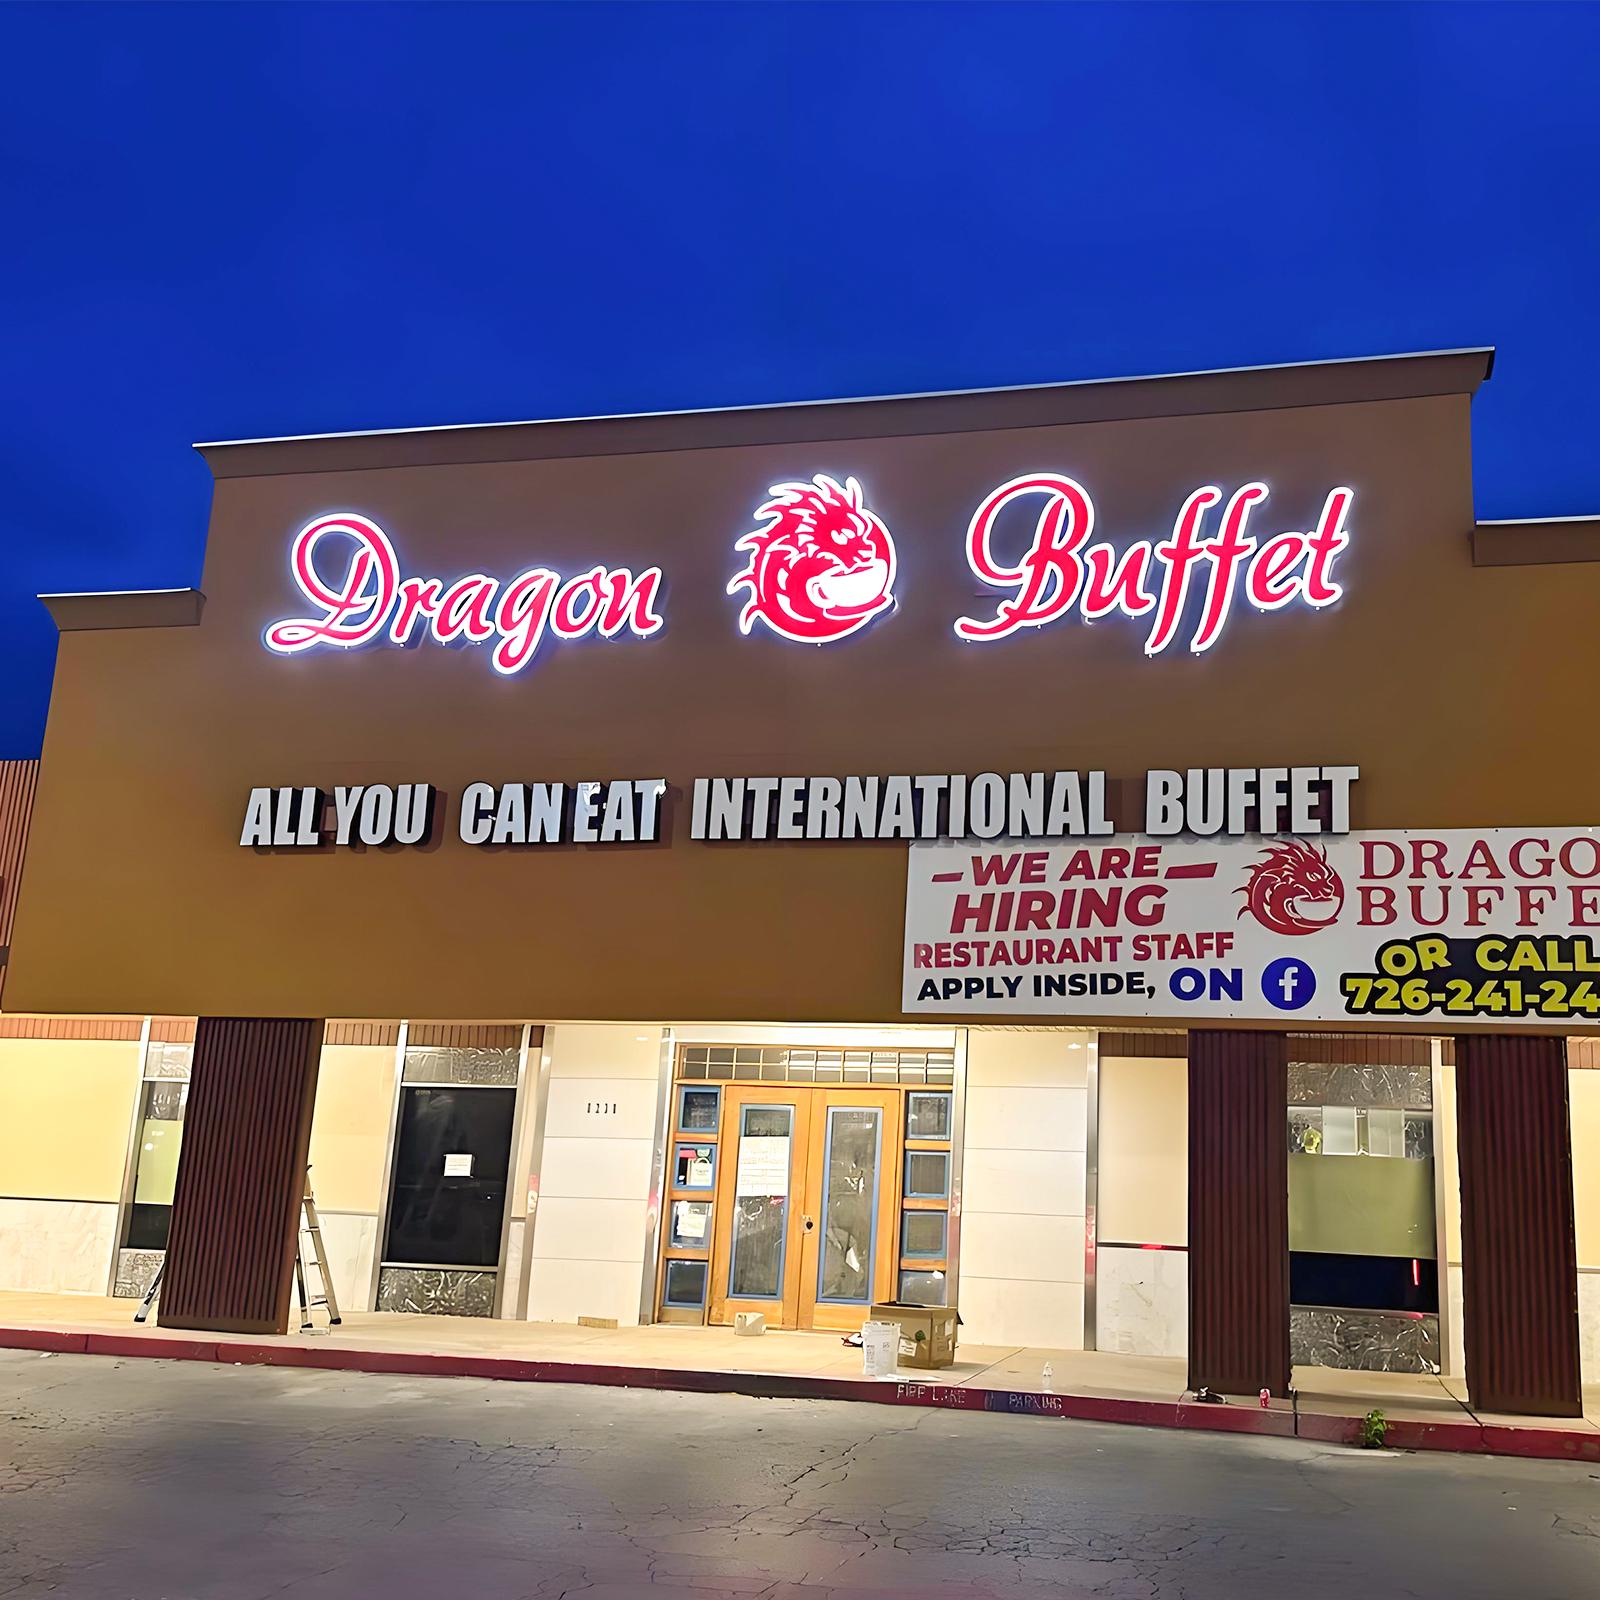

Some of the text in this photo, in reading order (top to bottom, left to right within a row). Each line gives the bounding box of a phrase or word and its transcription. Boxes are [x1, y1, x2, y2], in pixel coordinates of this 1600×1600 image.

[954, 472, 1355, 656] Buffet
[265, 513, 663, 675] Dragon
[240, 766, 1360, 847] ALL YOU CAN EAT INTERNATIONAL BUFFET
[971, 845, 1162, 886] WE ARE
[1359, 837, 1600, 880] DRAGO
[950, 884, 1169, 934] HIRING
[1357, 885, 1600, 927] BUFFE
[914, 931, 1234, 968] RESTAURANT STAFF
[1381, 939, 1600, 976] OR CALL
[917, 975, 1023, 1001] APPLY
[1033, 971, 1155, 999] INSIDE,
[1169, 967, 1243, 1001] ON
[1346, 977, 1600, 1013] 726-241-24
